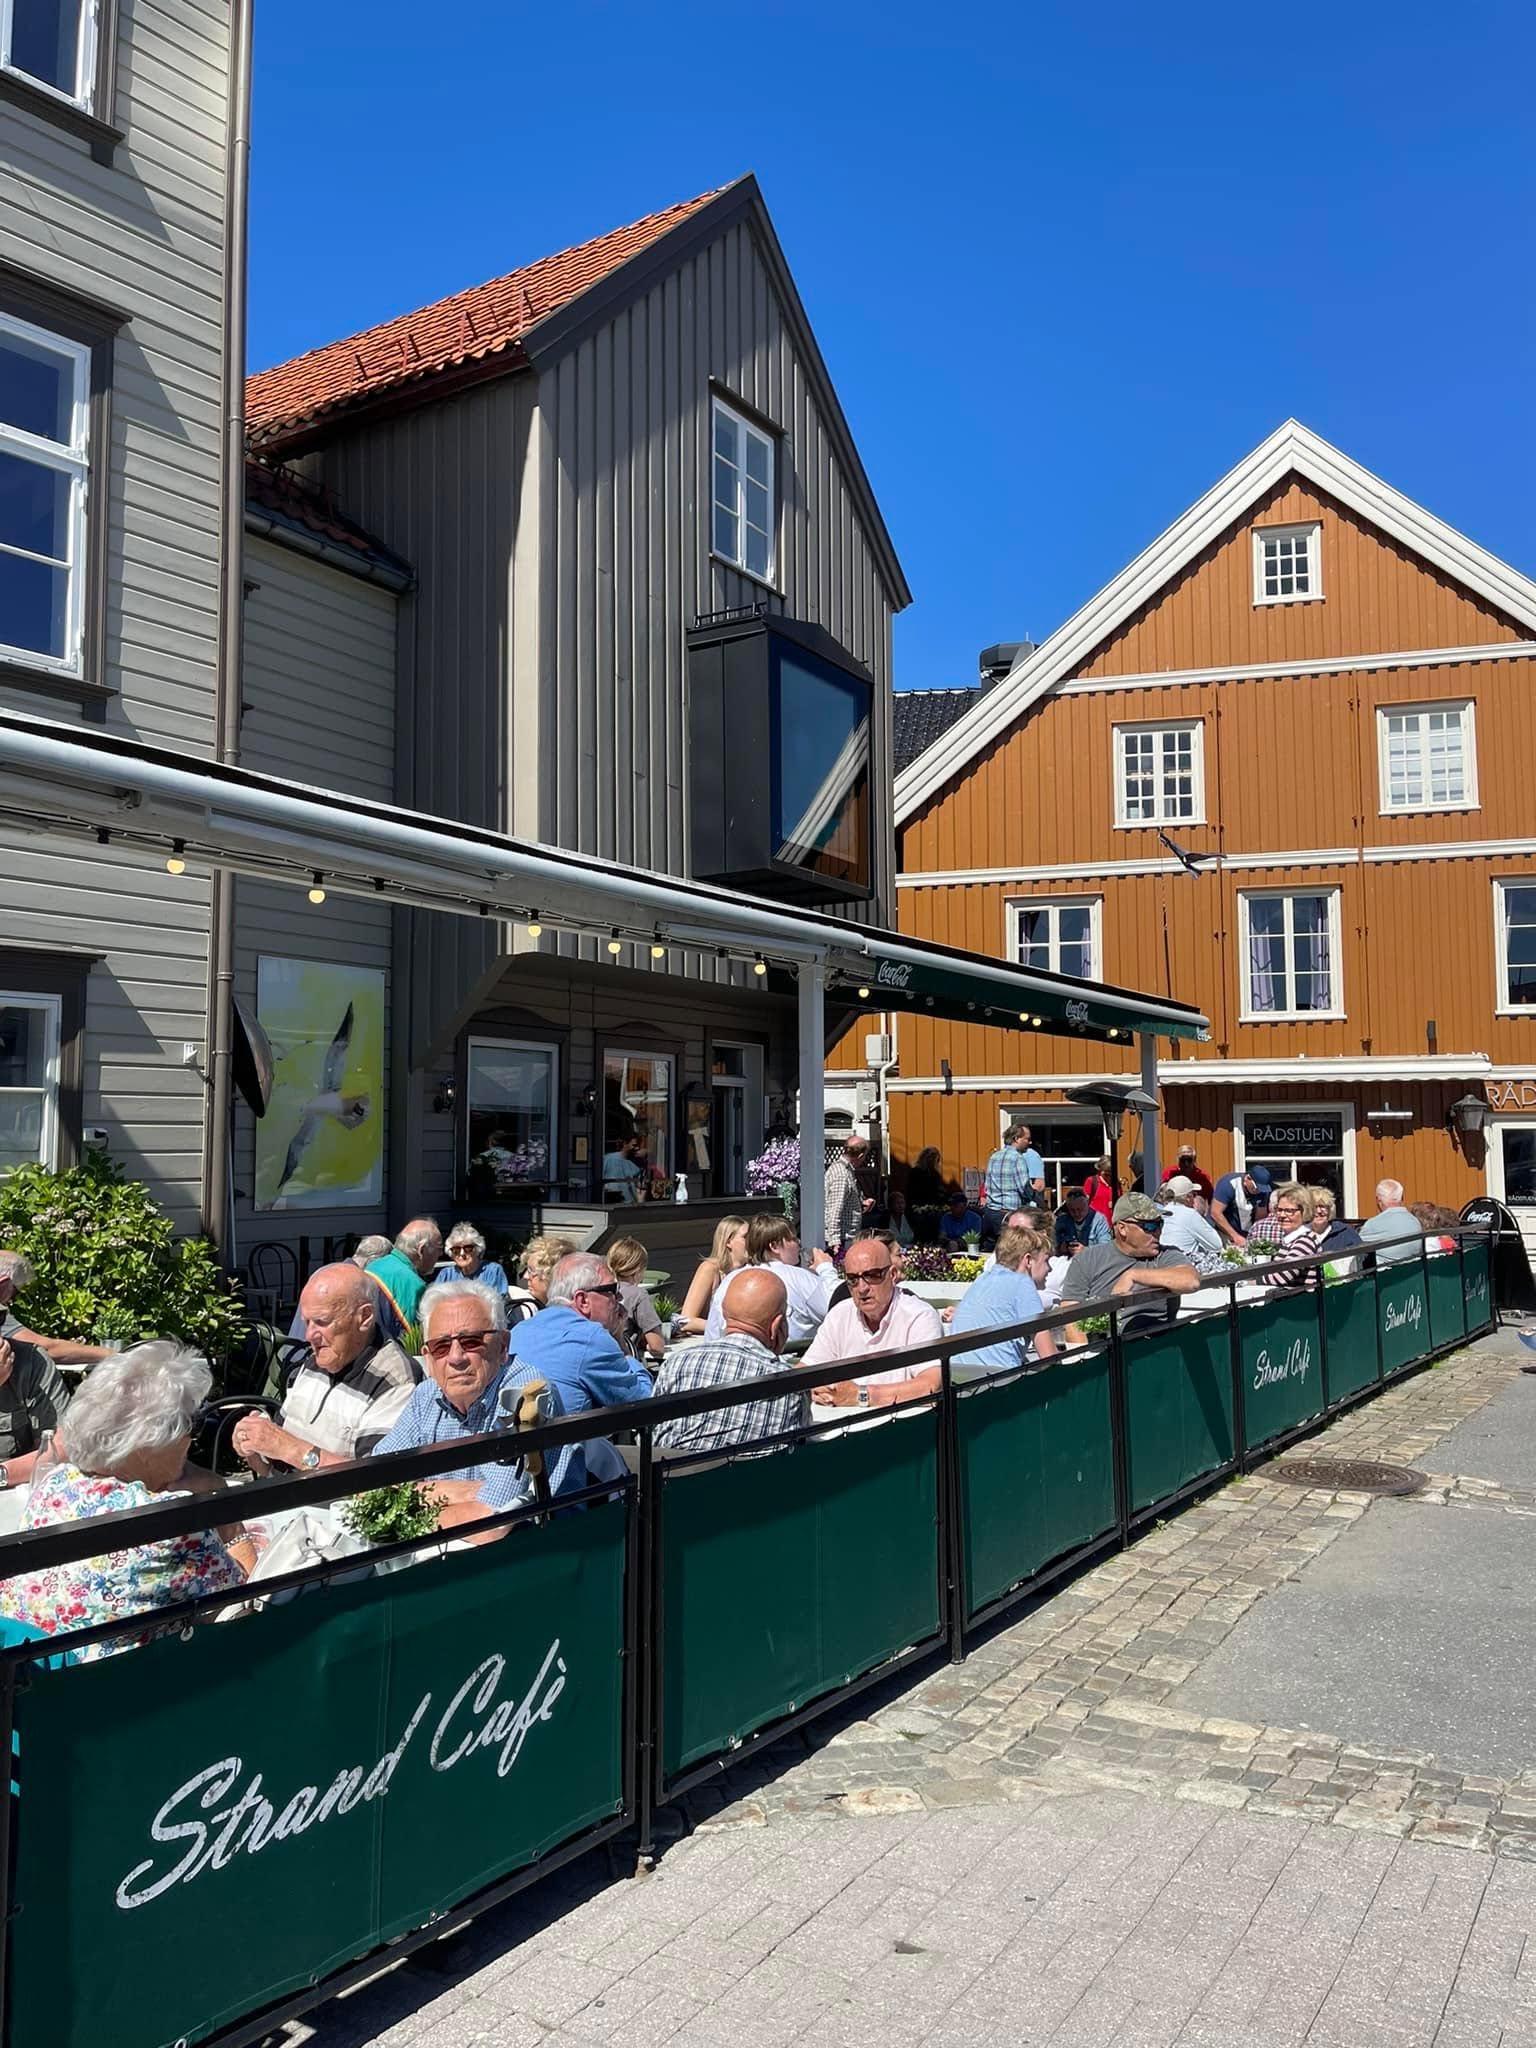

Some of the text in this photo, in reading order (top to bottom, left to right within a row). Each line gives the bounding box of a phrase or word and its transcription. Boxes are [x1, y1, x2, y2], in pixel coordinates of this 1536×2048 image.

[1253, 1124, 1334, 1141] RÅDSTUEN
[1253, 1346, 1292, 1390] Strand
[116, 1692, 432, 1910] Strand
